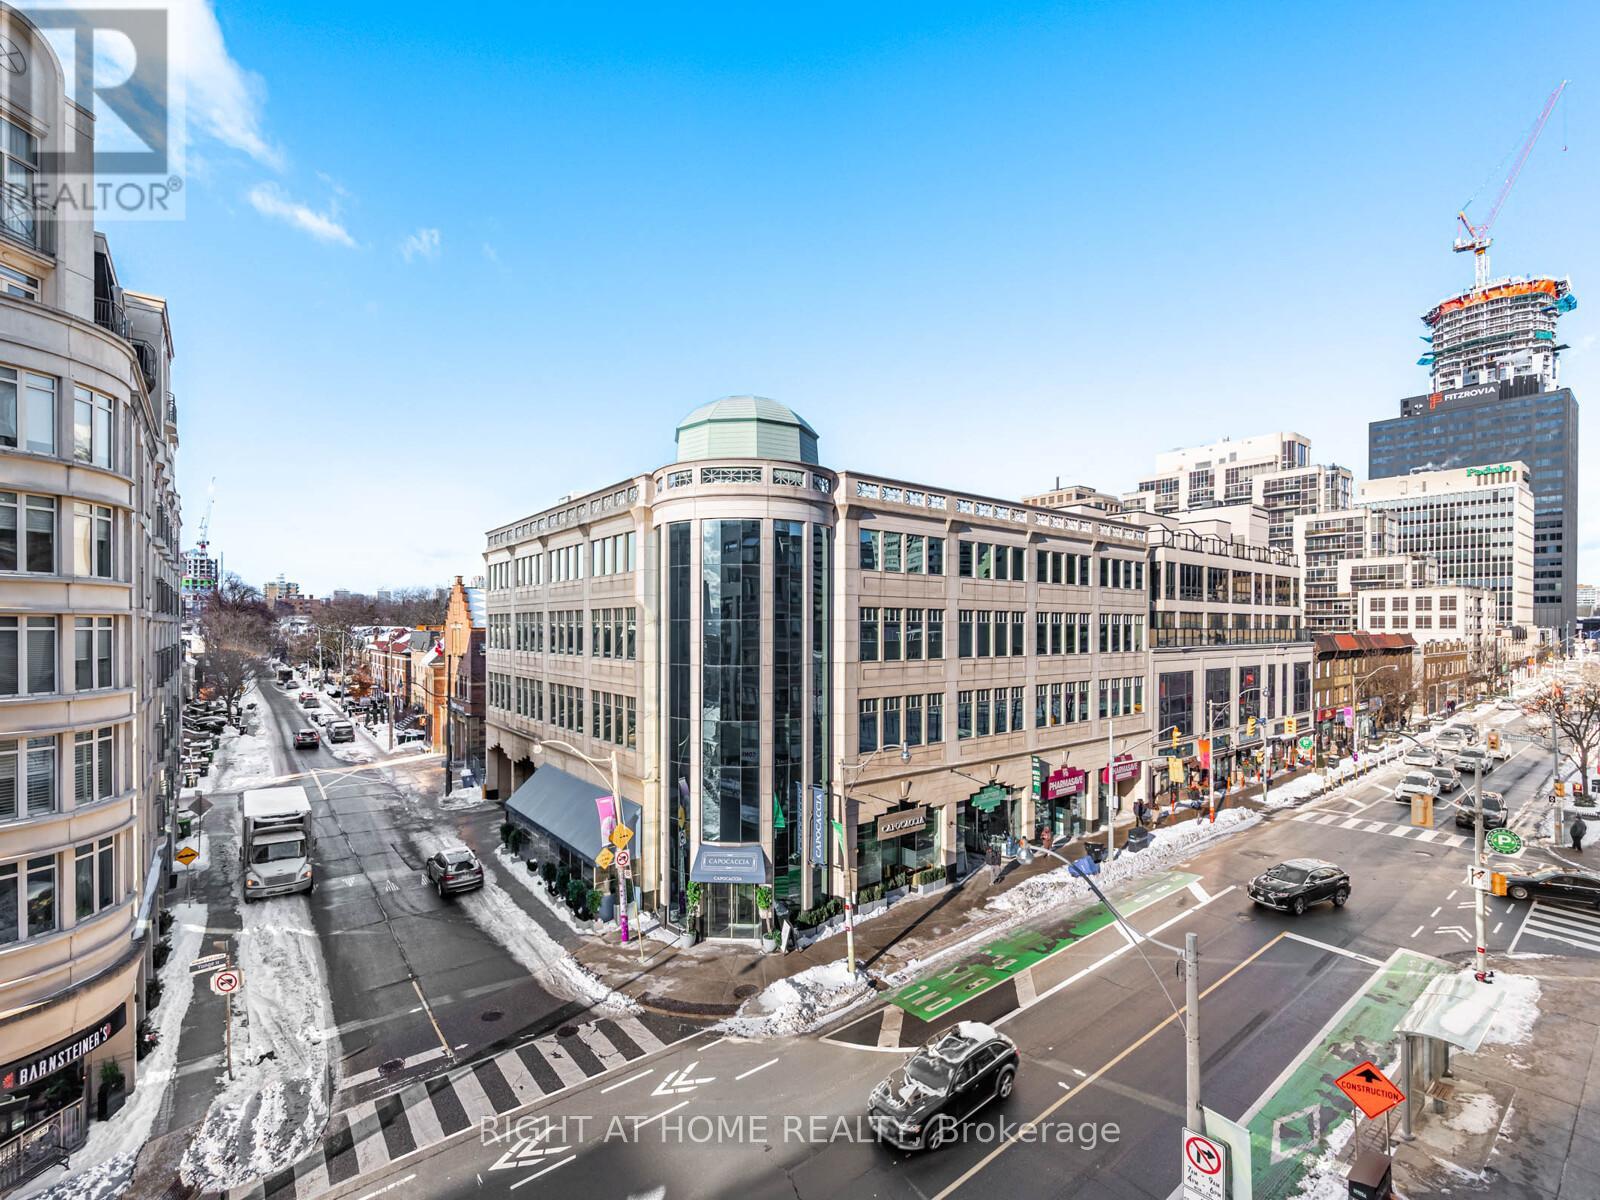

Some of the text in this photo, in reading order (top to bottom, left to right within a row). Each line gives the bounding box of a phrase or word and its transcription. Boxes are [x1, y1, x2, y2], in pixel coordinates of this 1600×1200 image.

[1444, 386, 1496, 401] FITZROVIA
[1466, 464, 1512, 477] Padulo
[1049, 775, 1083, 791] PHARMASAVE
[708, 857, 750, 865] CAPOCACCIA
[19, 1025, 108, 1086] BARNSTEINER'S
[1341, 1080, 1399, 1100] CONSTRUCTION
